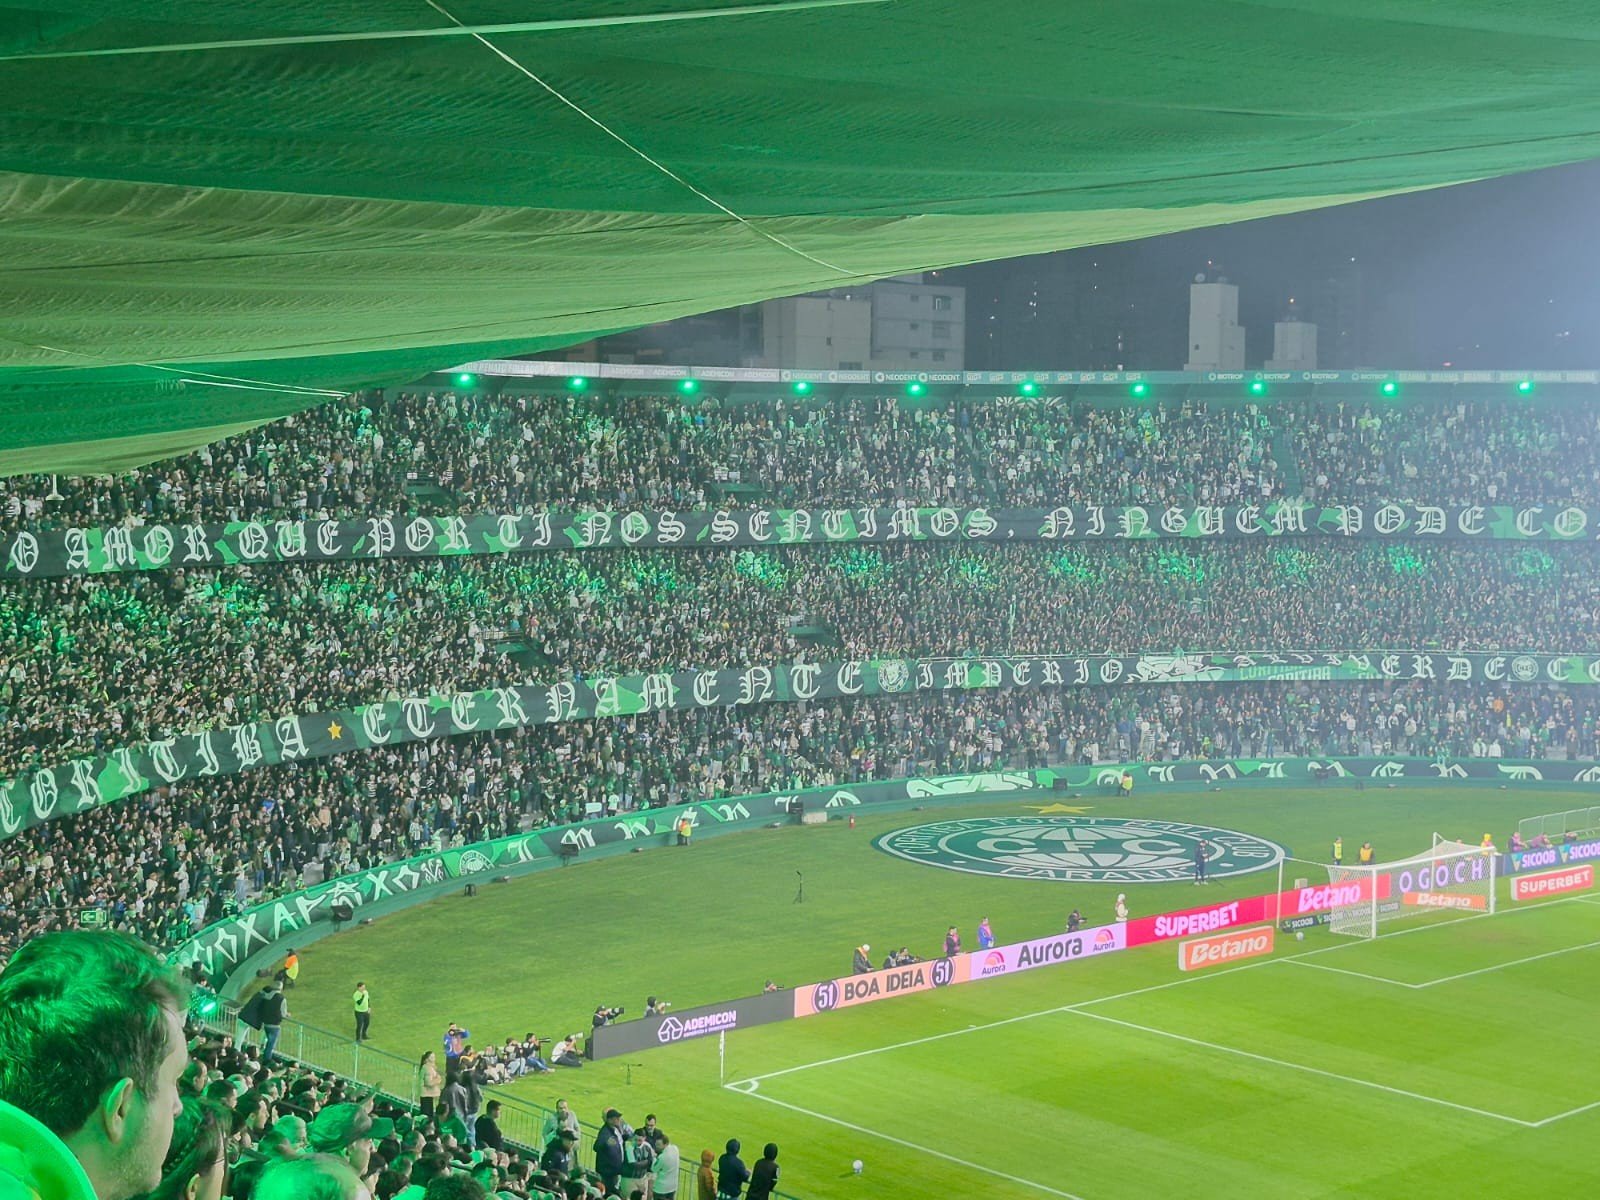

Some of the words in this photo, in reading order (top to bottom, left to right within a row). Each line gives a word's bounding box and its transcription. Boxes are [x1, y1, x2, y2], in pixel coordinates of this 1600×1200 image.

[10, 531, 39, 573] O
[64, 524, 213, 571] AMOR
[238, 519, 342, 560] QUE
[367, 516, 472, 558] POR
[497, 511, 551, 548] TI
[577, 510, 686, 547] NOS
[1335, 504, 1486, 537] PODE
[918, 658, 1124, 689] IMPERIO
[0, 715, 309, 834] CORITIBA
[362, 659, 864, 745] ETERNAMENTE
[894, 821, 984, 855] CORITIBA
[990, 817, 1105, 826] FOOT
[1121, 820, 1214, 836] BALL
[1212, 835, 1271, 859] CLUB
[1521, 849, 1557, 869] SICOOB
[1519, 869, 1591, 894] SUPERBET
[1298, 883, 1361, 913] Betano
[1416, 892, 1472, 907] Betano
[1153, 900, 1240, 938] SUPERBET
[1016, 936, 1083, 969] Aurora
[1092, 940, 1116, 952] Aurora
[1189, 935, 1269, 966] Betano
[844, 977, 880, 1001] BOA
[886, 967, 925, 993] IDEIA
[934, 960, 950, 985] 51
[981, 963, 1006, 976] Aurora
[817, 984, 835, 1009] 51
[683, 1009, 737, 1032] ADEMICON
